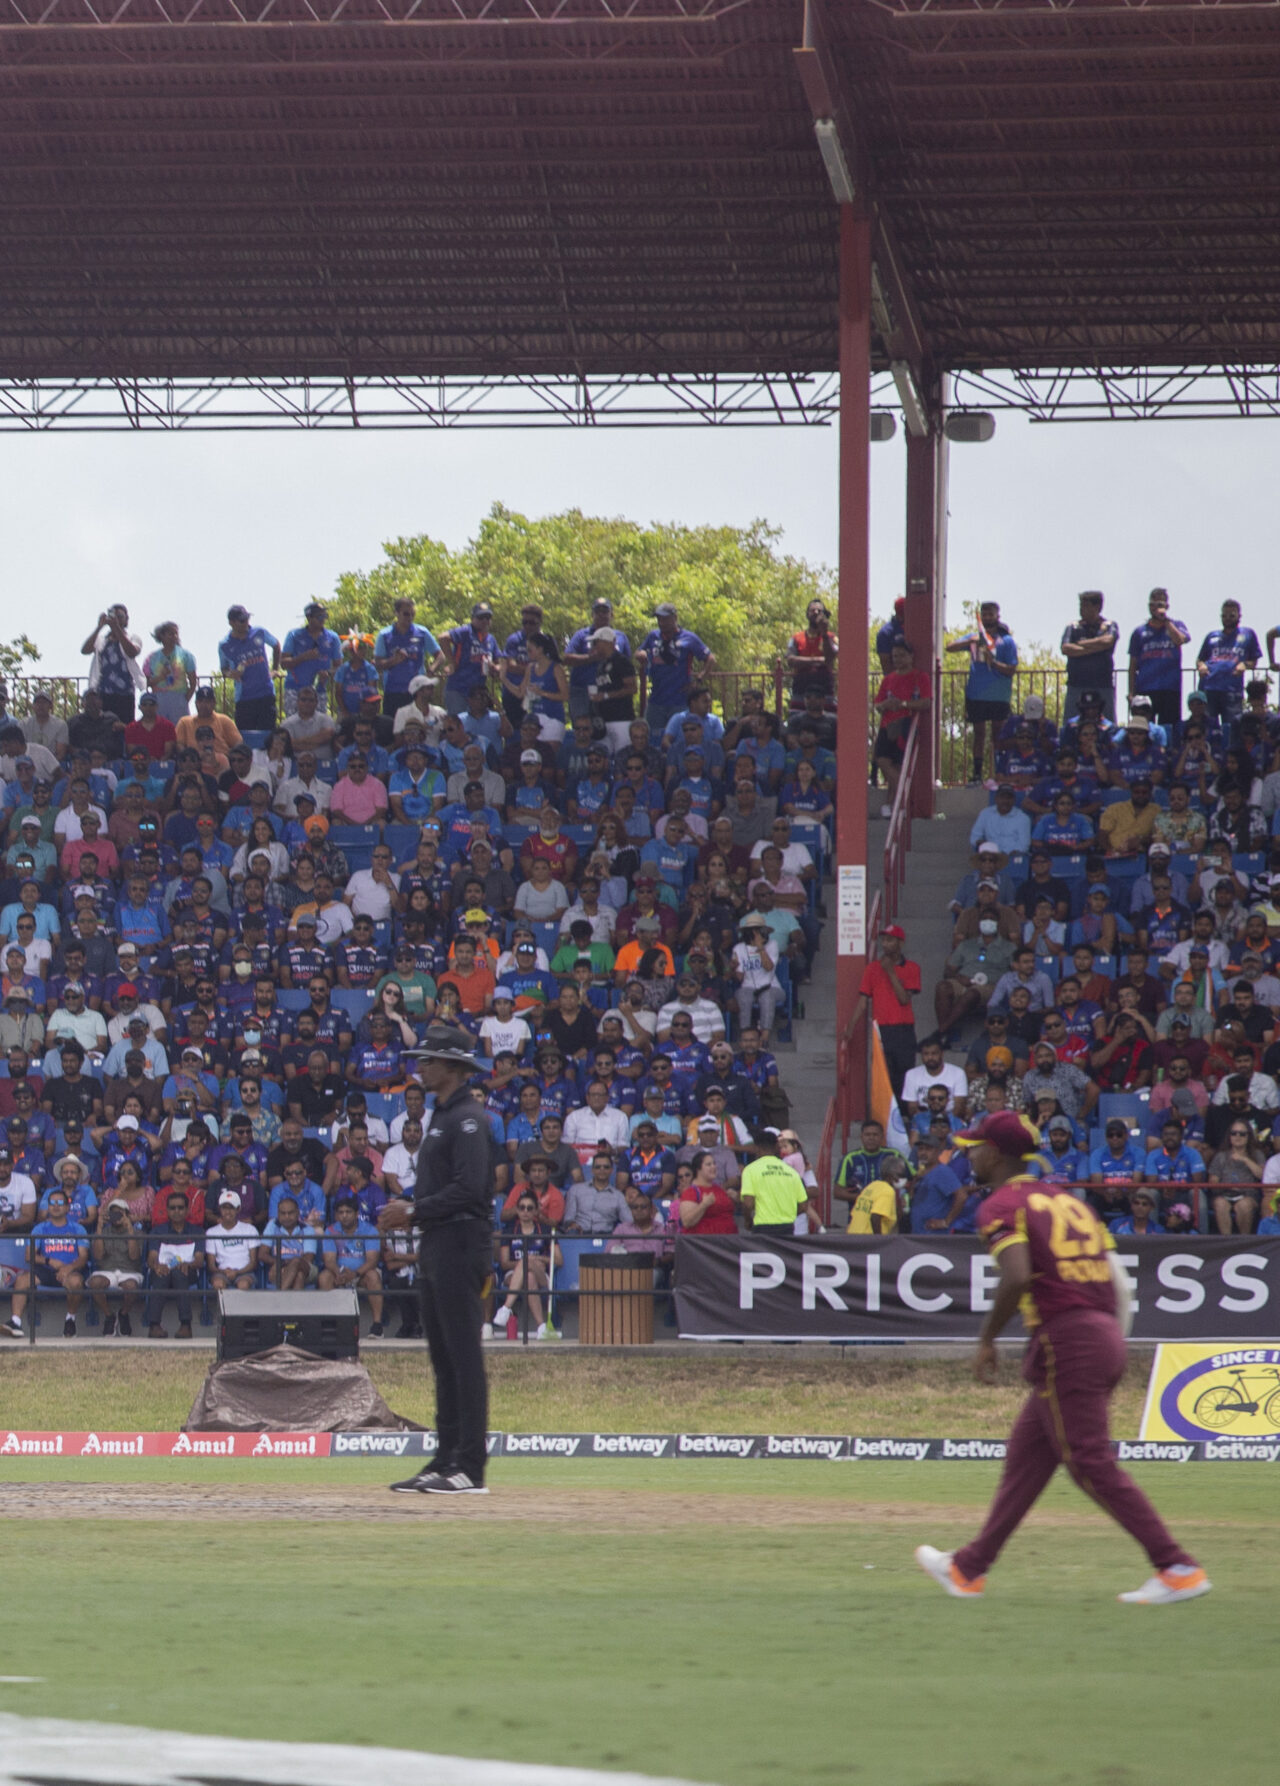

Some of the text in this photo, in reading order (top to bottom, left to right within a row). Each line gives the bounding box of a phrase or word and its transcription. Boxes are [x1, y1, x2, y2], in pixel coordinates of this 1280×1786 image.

[1027, 1192, 1101, 1259] 29
[44, 1244, 75, 1253] INDIA
[739, 1253, 1269, 1313] PRICESS
[1211, 1350, 1267, 1368] SINCE
[0, 1433, 63, 1455] Amul
[81, 1433, 144, 1455] Amul
[171, 1433, 234, 1455] Amul
[252, 1433, 316, 1455] Amul
[335, 1434, 409, 1456] betway
[506, 1435, 580, 1457] betway
[593, 1435, 668, 1458] betway
[679, 1435, 755, 1458] betway
[767, 1436, 843, 1460] betway
[854, 1438, 930, 1461] betway
[943, 1439, 1007, 1458] betwa
[1118, 1441, 1194, 1462] betway
[1205, 1441, 1280, 1462] betway
